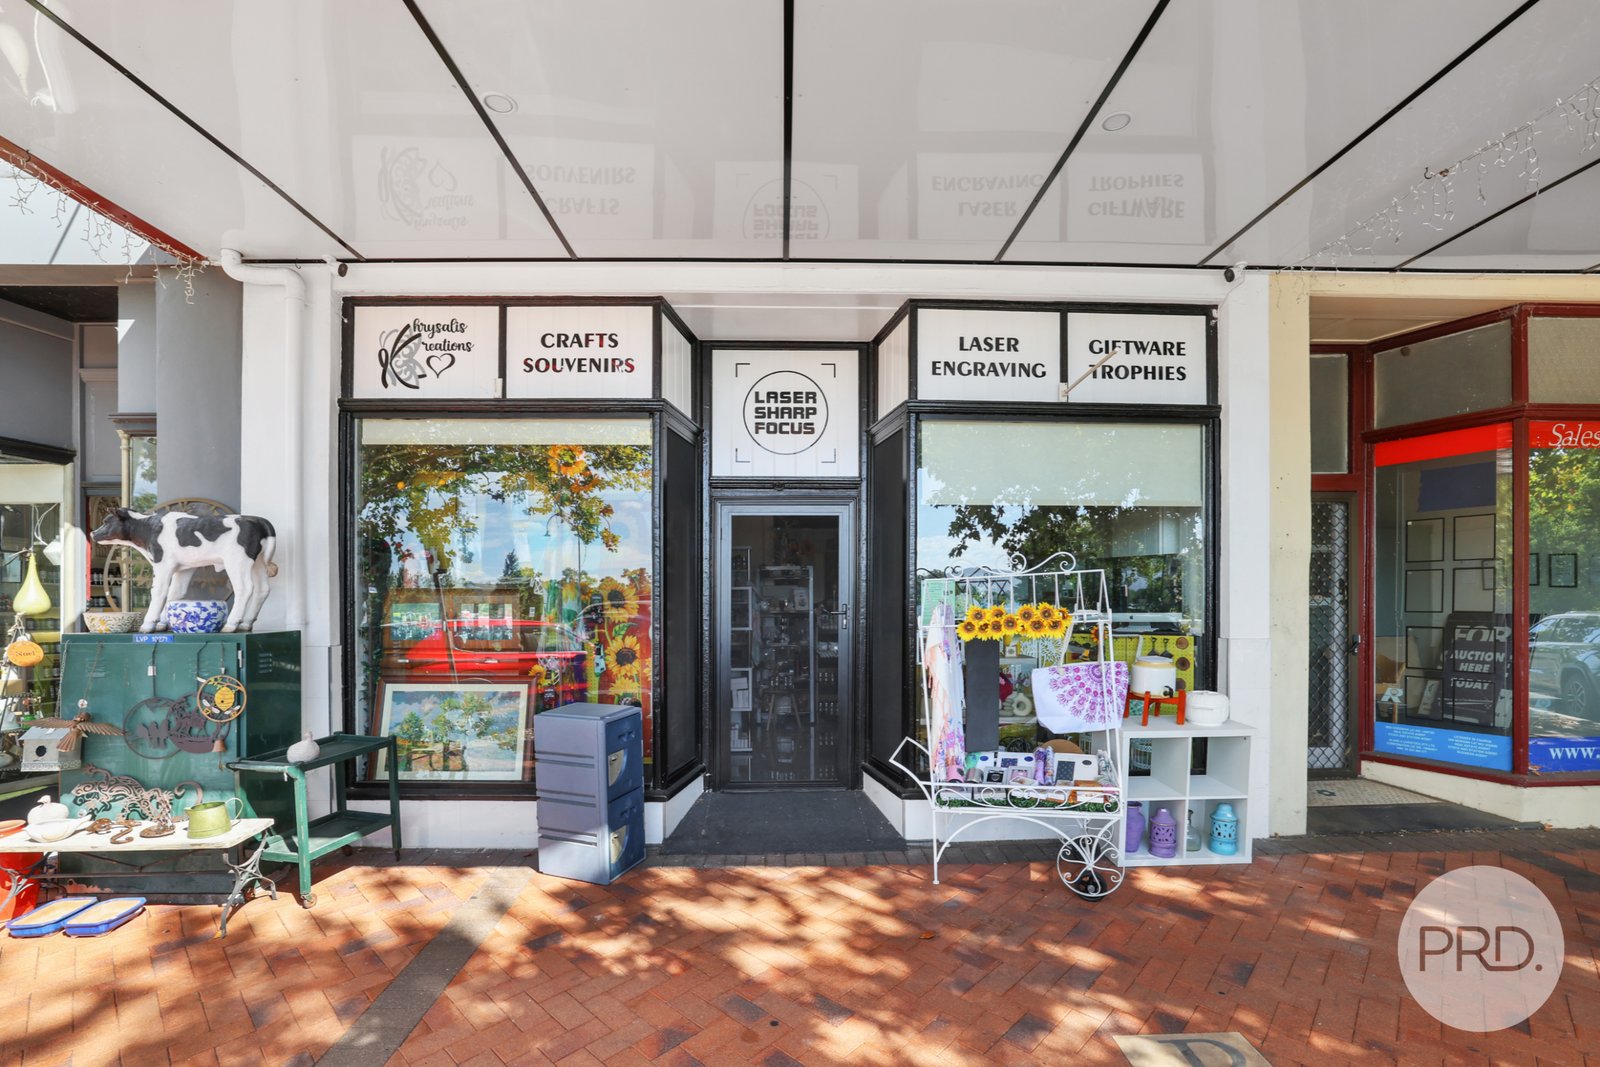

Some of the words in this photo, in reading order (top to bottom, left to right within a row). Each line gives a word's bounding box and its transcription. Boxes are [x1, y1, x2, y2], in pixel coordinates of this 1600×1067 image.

[540, 333, 619, 348] CRAFTS
[959, 336, 1019, 352] LASER
[1088, 339, 1186, 356] GIFTWARE
[523, 357, 635, 373] SOUVENIRS
[931, 361, 1047, 378] ENGRAVING
[1088, 365, 1187, 381] TROPHIES
[754, 391, 817, 404] LASER
[754, 406, 817, 419] SHARP
[754, 422, 815, 434] FOCUS
[1548, 423, 1600, 447] Sales
[1454, 625, 1512, 642] FOR
[1450, 650, 1505, 662] AUCTION
[1459, 662, 1490, 673] HERE
[1450, 678, 1490, 690] TODAY
